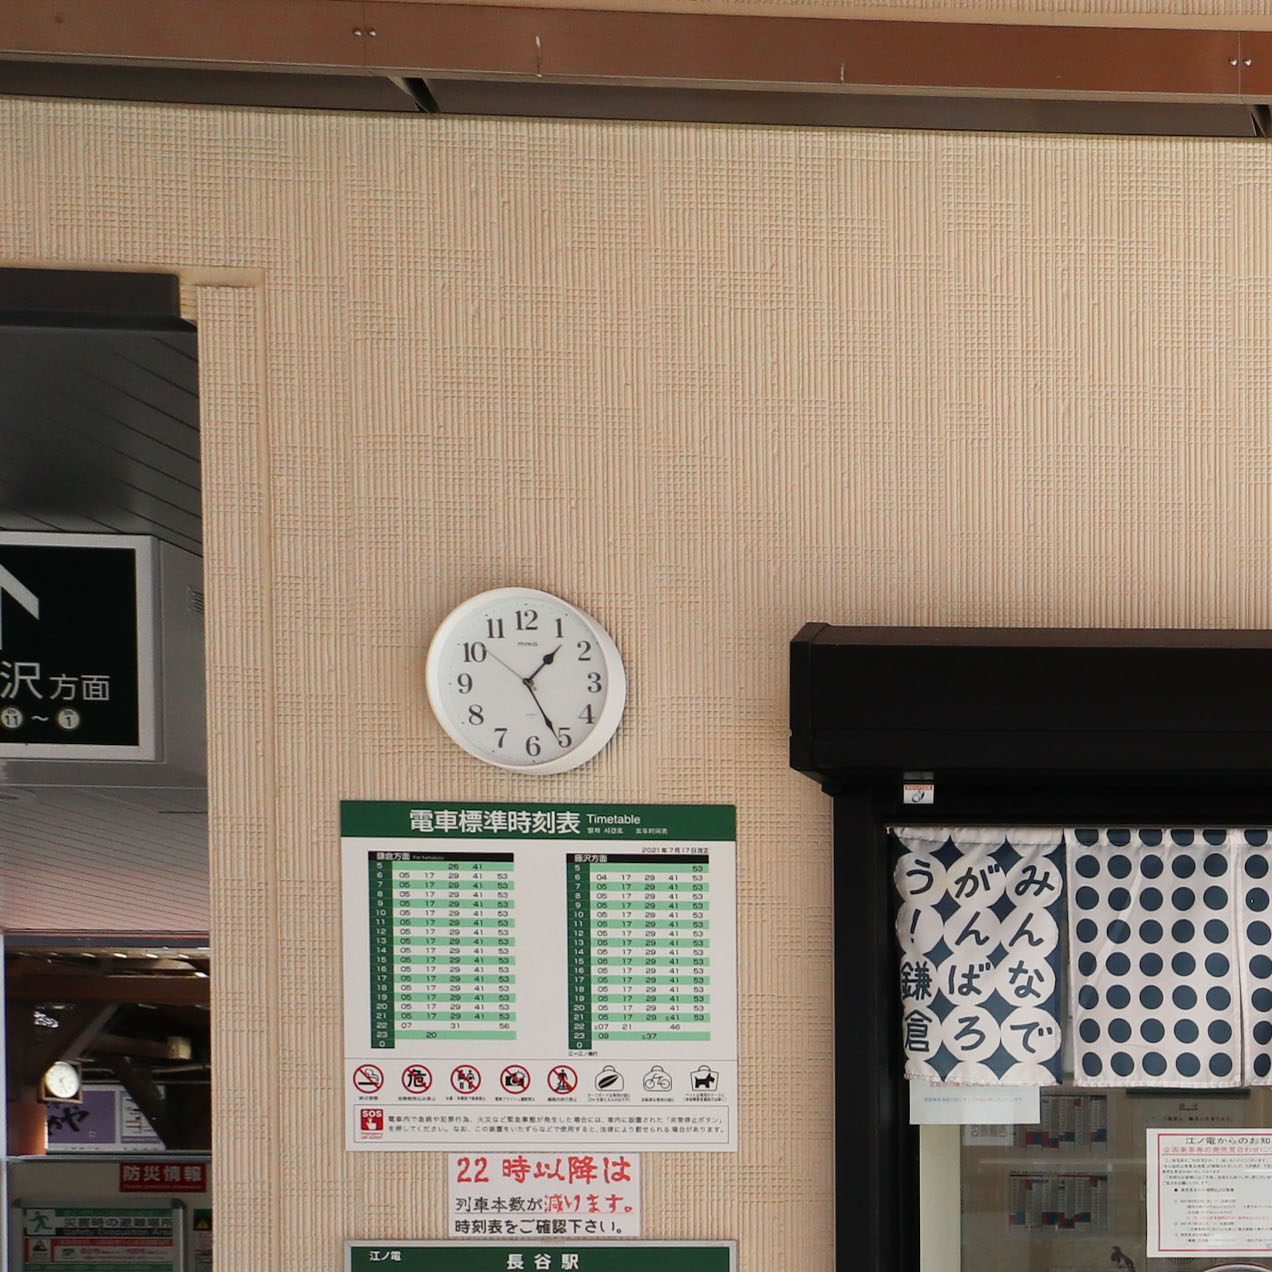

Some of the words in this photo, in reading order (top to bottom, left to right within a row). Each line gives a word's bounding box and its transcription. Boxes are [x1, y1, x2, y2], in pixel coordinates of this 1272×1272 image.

[487, 618, 504, 638] 11
[515, 609, 538, 630] 12
[555, 618, 564, 638] 1
[463, 642, 486, 662] 10
[577, 640, 591, 661] 2
[457, 673, 472, 694] 9
[587, 672, 602, 693] 3
[468, 704, 484, 725] 8
[578, 704, 595, 724] 4
[494, 728, 507, 748] 7
[526, 736, 541, 756] 6
[558, 728, 572, 747] 5
[409, 810, 580, 834] 電車標準時刻表
[587, 814, 640, 824] Timetable
[123, 1166, 202, 1182] 防災情報
[455, 1194, 632, 1213] 列車本数が減ります。
[455, 1219, 622, 1235] 時刻表をご確認下さい。
